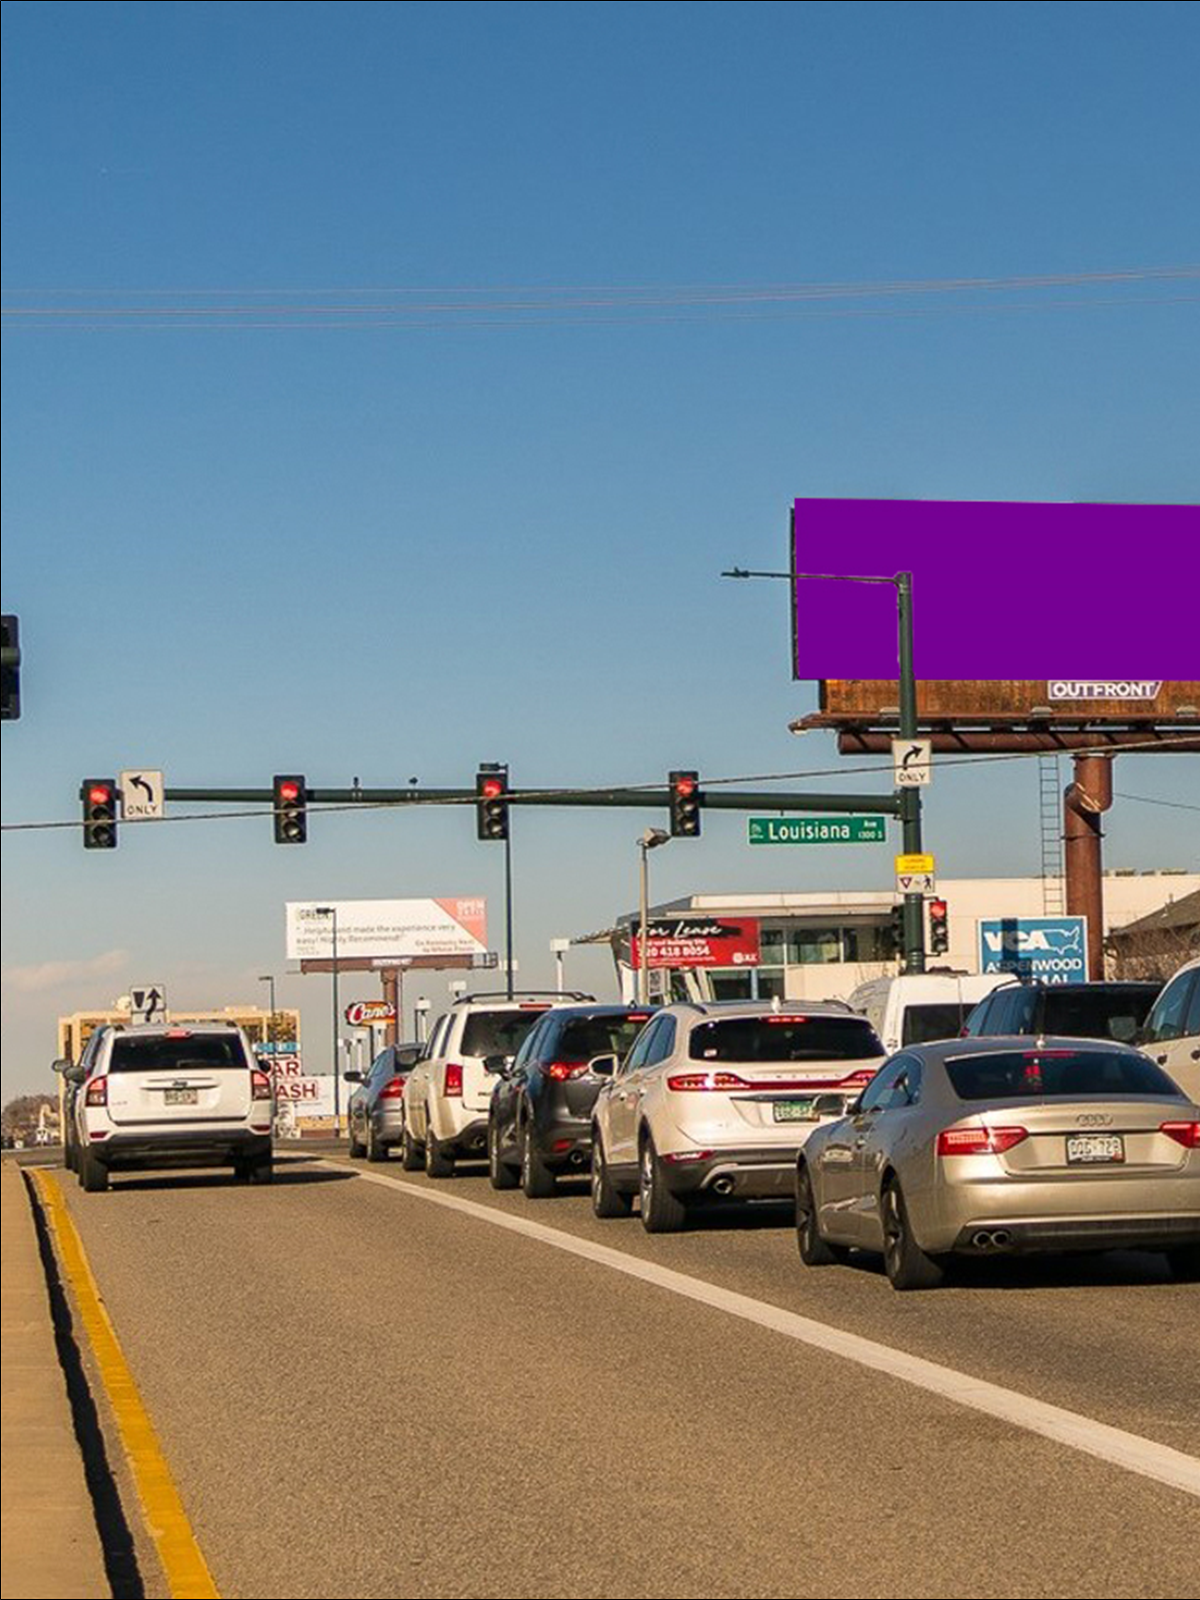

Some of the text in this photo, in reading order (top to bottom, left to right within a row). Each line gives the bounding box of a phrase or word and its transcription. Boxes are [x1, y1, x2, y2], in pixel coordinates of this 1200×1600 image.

[1053, 682, 1156, 697] OUTFRONT
[898, 771, 926, 782] ONLY
[127, 804, 158, 815] ONLY
[768, 821, 850, 840] Louisiana
[674, 921, 722, 938] Lease
[984, 931, 1051, 952] VCA
[267, 1060, 300, 1077] AR
[276, 1083, 316, 1099] ASH
